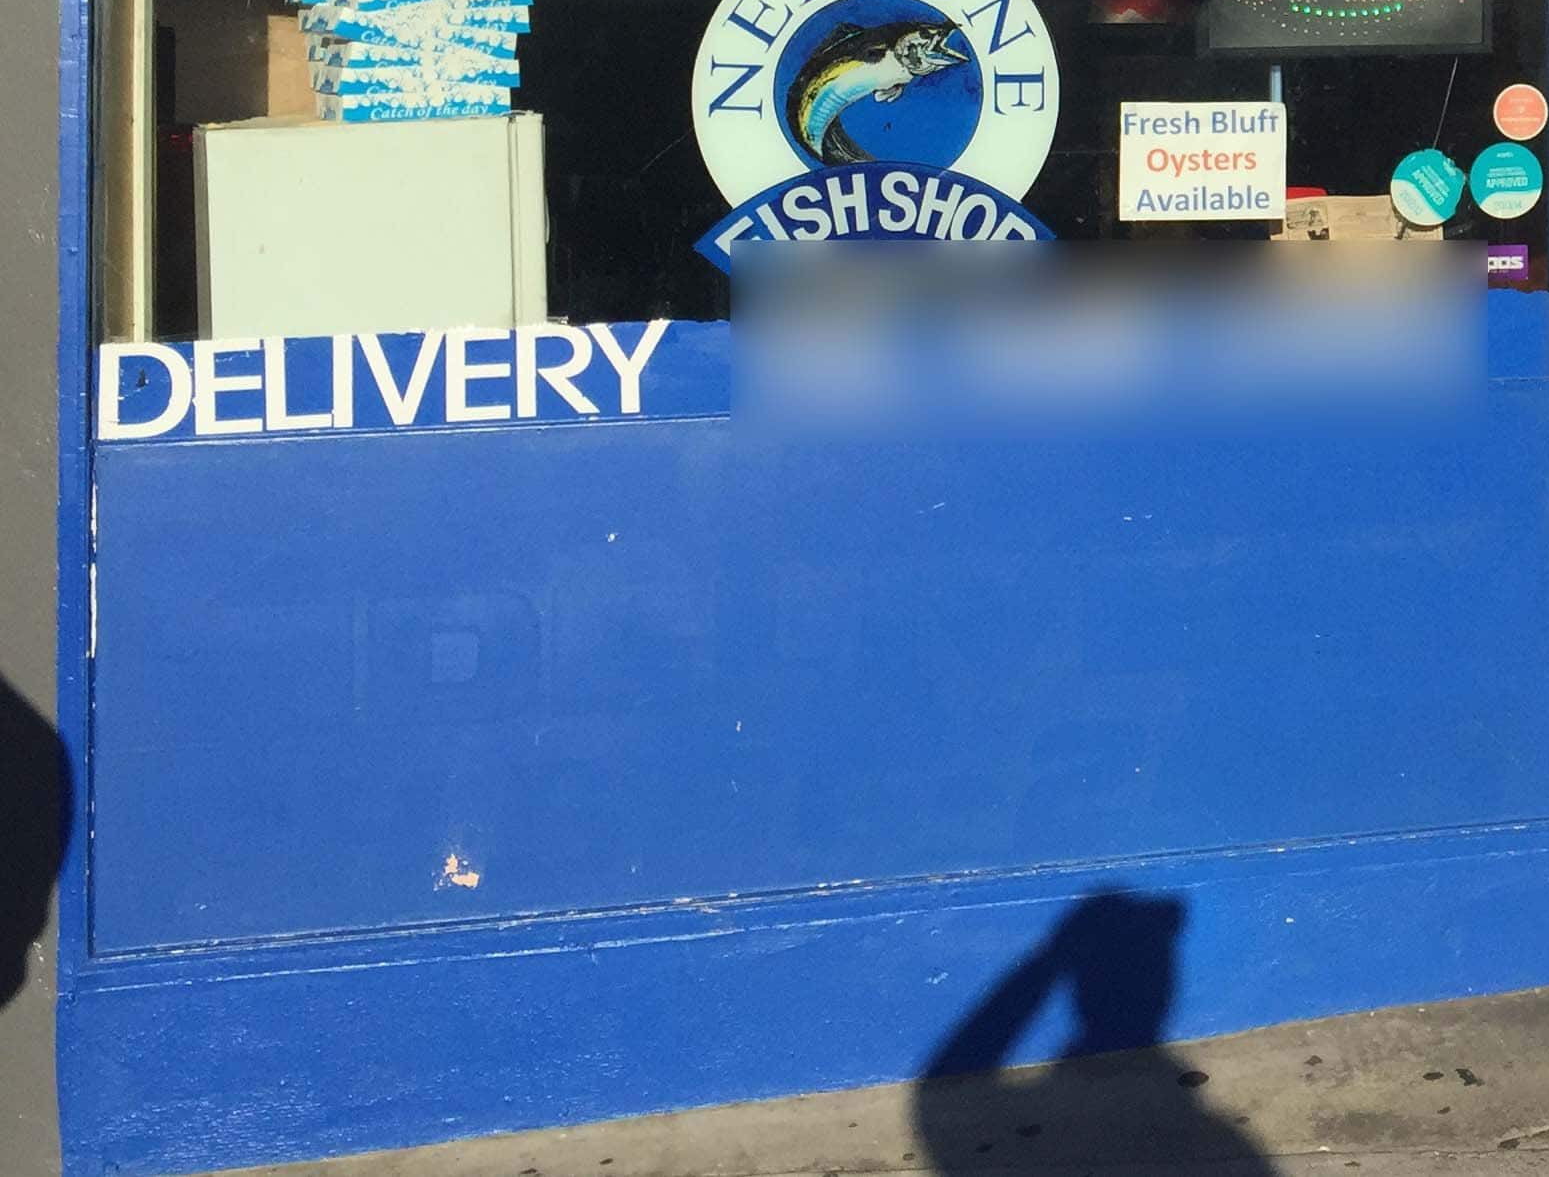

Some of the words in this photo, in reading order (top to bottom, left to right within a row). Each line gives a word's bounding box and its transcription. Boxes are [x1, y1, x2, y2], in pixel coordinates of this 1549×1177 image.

[370, 106, 414, 120] Catch
[417, 105, 432, 120] of
[461, 102, 489, 116] day
[1123, 110, 1201, 135] Fresh
[1146, 148, 1257, 178] Oysters
[1486, 176, 1529, 189] APPROVED
[1136, 185, 1270, 212] Available
[97, 319, 672, 441] DELIVERY
